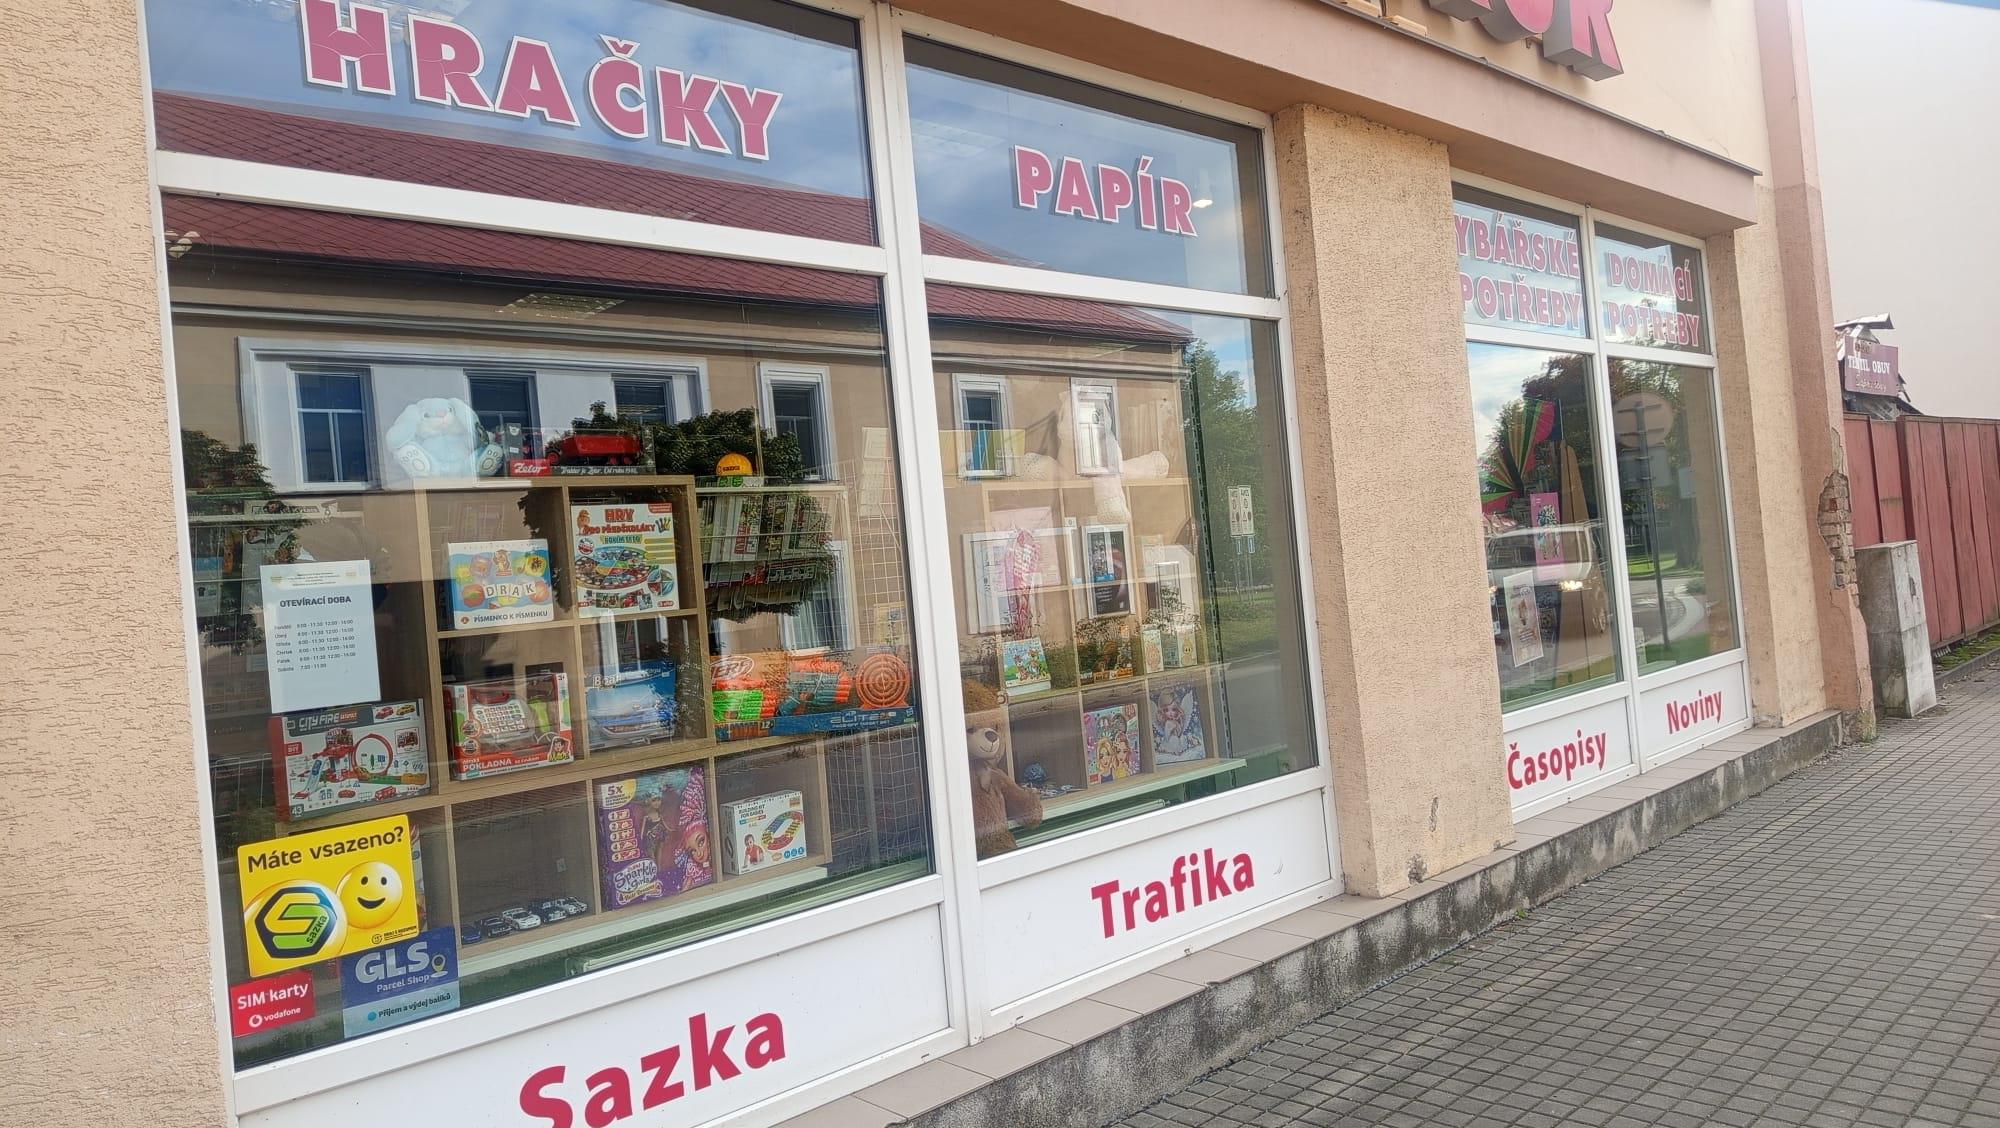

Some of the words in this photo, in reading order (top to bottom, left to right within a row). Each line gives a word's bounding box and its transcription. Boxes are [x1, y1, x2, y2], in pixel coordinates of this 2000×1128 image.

[300, 0, 782, 160] HRAČKY
[1014, 145, 1197, 236] PAPÍR
[1608, 251, 1693, 301] DOMÁCÍ
[605, 508, 634, 522] HRY
[280, 596, 326, 607] OTEVÍRACÍ
[327, 596, 352, 604] DOBA
[486, 583, 535, 597] DRAK
[473, 614, 508, 623] PÍSMENKO
[298, 716, 319, 730] CITY
[319, 712, 340, 725] FIRE
[1666, 690, 1722, 735] Noviny
[463, 758, 512, 772] POKLADNA
[1507, 729, 1607, 790] Časopisy
[247, 850, 302, 873] Máte
[310, 826, 404, 860] vsazeno?
[614, 861, 657, 889] Sparkle
[1091, 848, 1255, 939] Trafika
[355, 941, 430, 984] GLS
[237, 991, 266, 1010] SIM
[269, 983, 309, 1002] karty
[376, 979, 406, 993] Parcel
[407, 975, 430, 988] Shop
[264, 1007, 301, 1022] vodafone
[378, 1007, 402, 1018] Příjem
[408, 1000, 428, 1011] výdej
[429, 992, 451, 1005] balíků
[519, 1012, 786, 1128] Sazka
